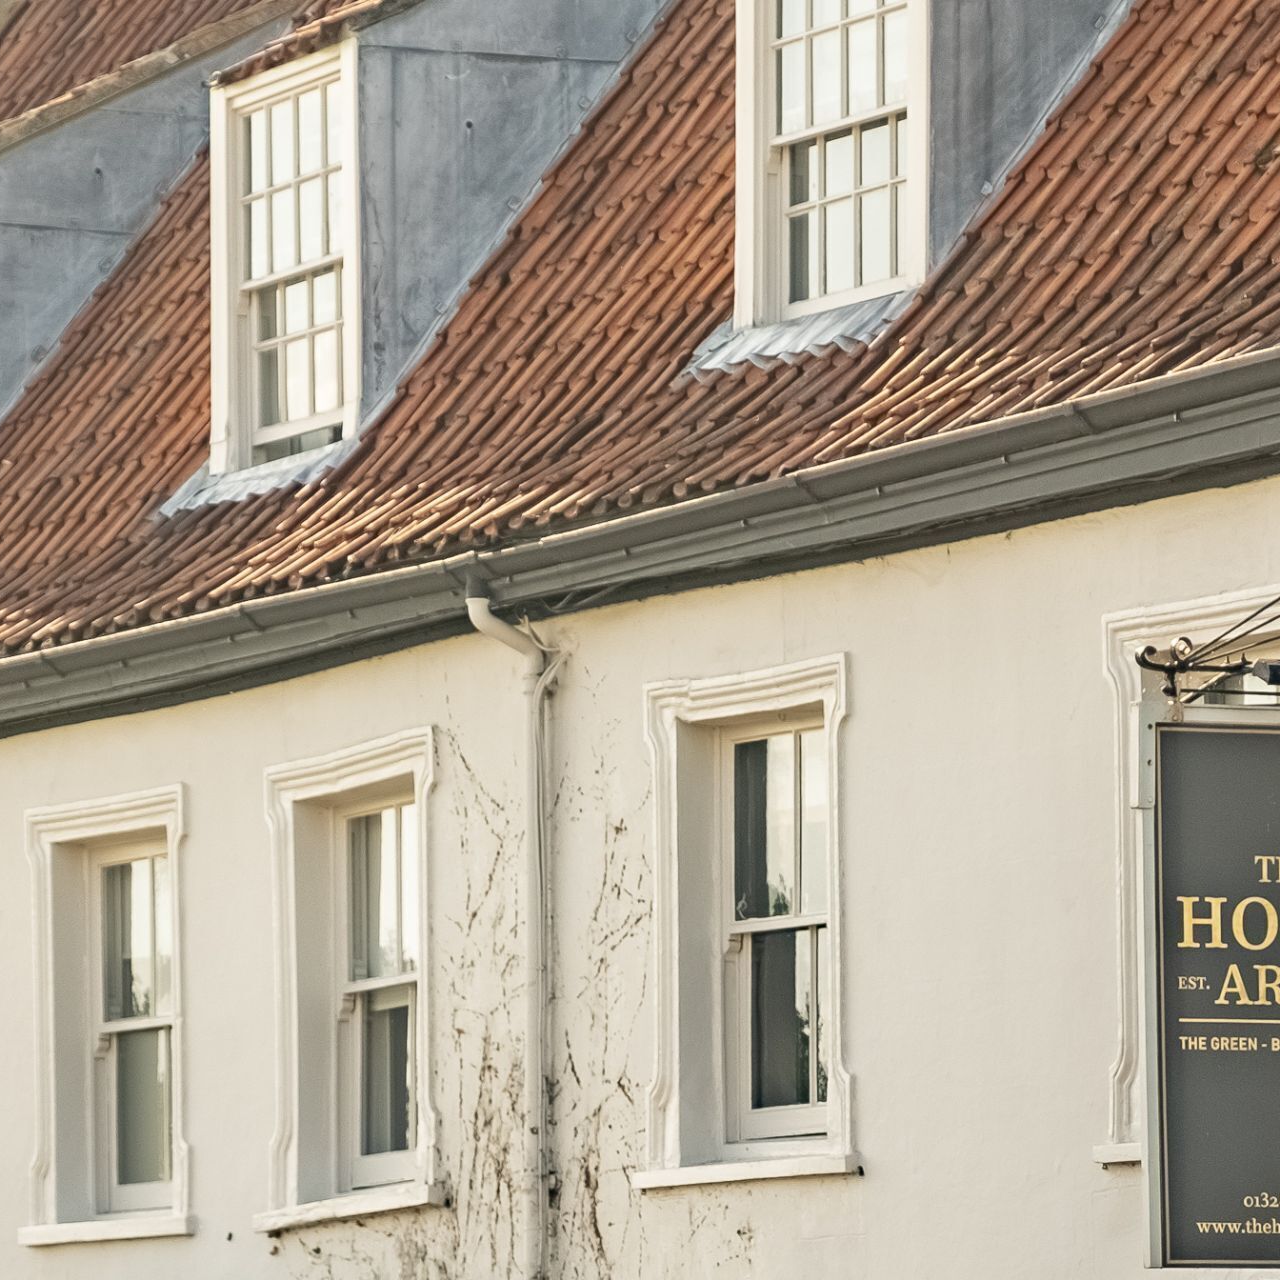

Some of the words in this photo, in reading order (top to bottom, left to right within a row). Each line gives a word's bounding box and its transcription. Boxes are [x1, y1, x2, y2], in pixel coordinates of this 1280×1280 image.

[1177, 976, 1210, 990] EST.
[1179, 1036, 1208, 1051] THE
[1210, 1036, 1258, 1051] GREEN
